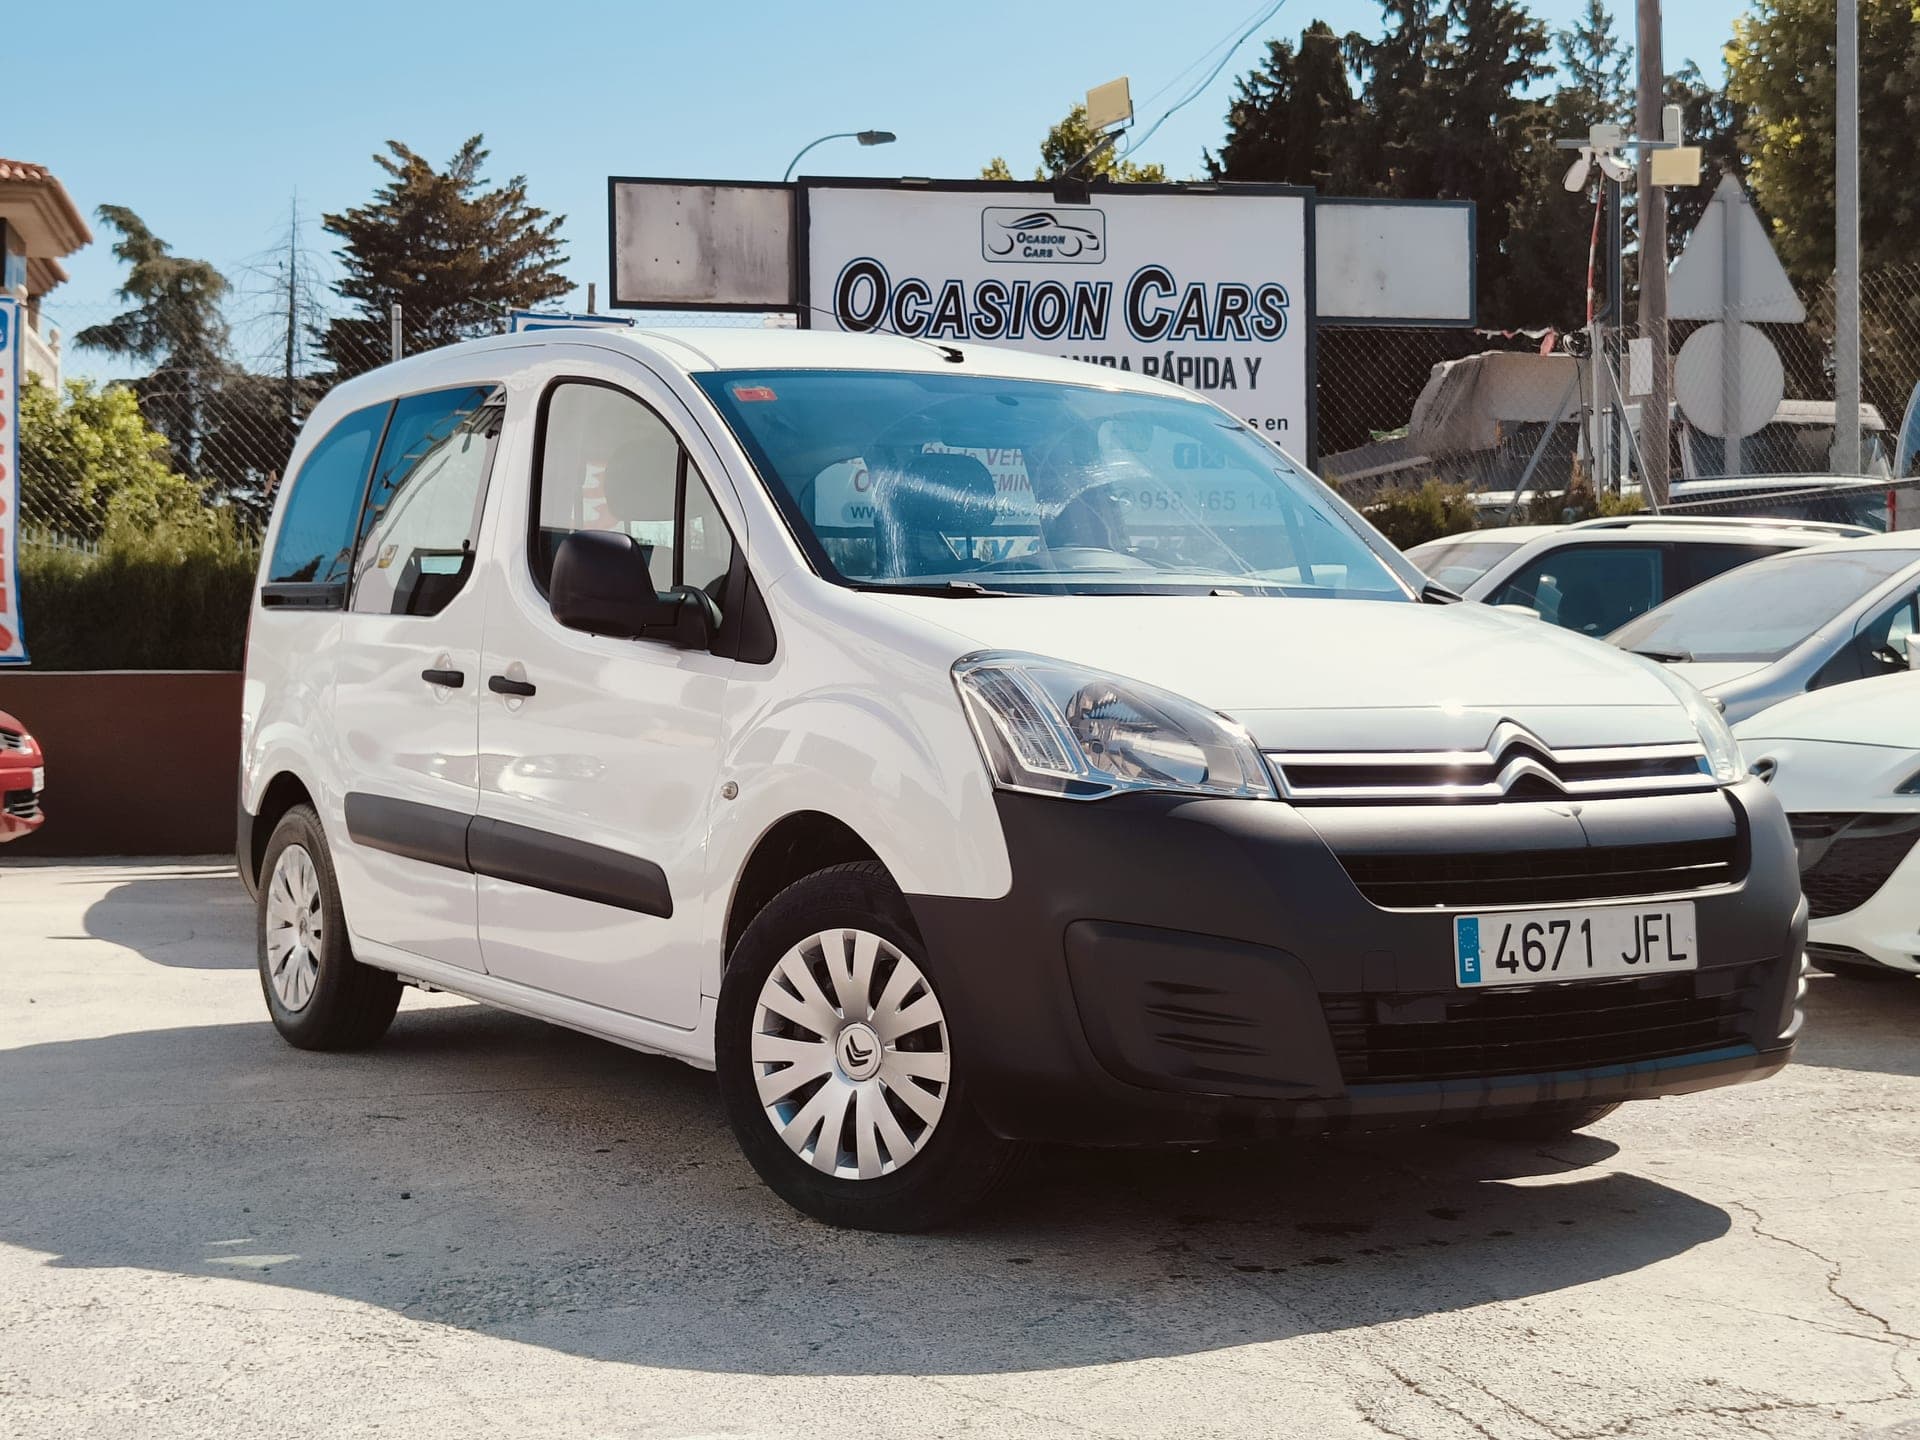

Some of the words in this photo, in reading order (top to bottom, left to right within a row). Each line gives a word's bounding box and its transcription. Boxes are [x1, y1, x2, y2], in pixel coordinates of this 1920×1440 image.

[1016, 232, 1066, 245] OCASION
[1023, 246, 1053, 258] CARS
[833, 256, 1113, 340] OCASION
[1125, 264, 1290, 342] CARS
[1245, 357, 1262, 389] Y
[1265, 418, 1288, 431] en
[1495, 919, 1593, 974] 4671
[1621, 913, 1687, 965] JFL
[1464, 957, 1475, 972] E
